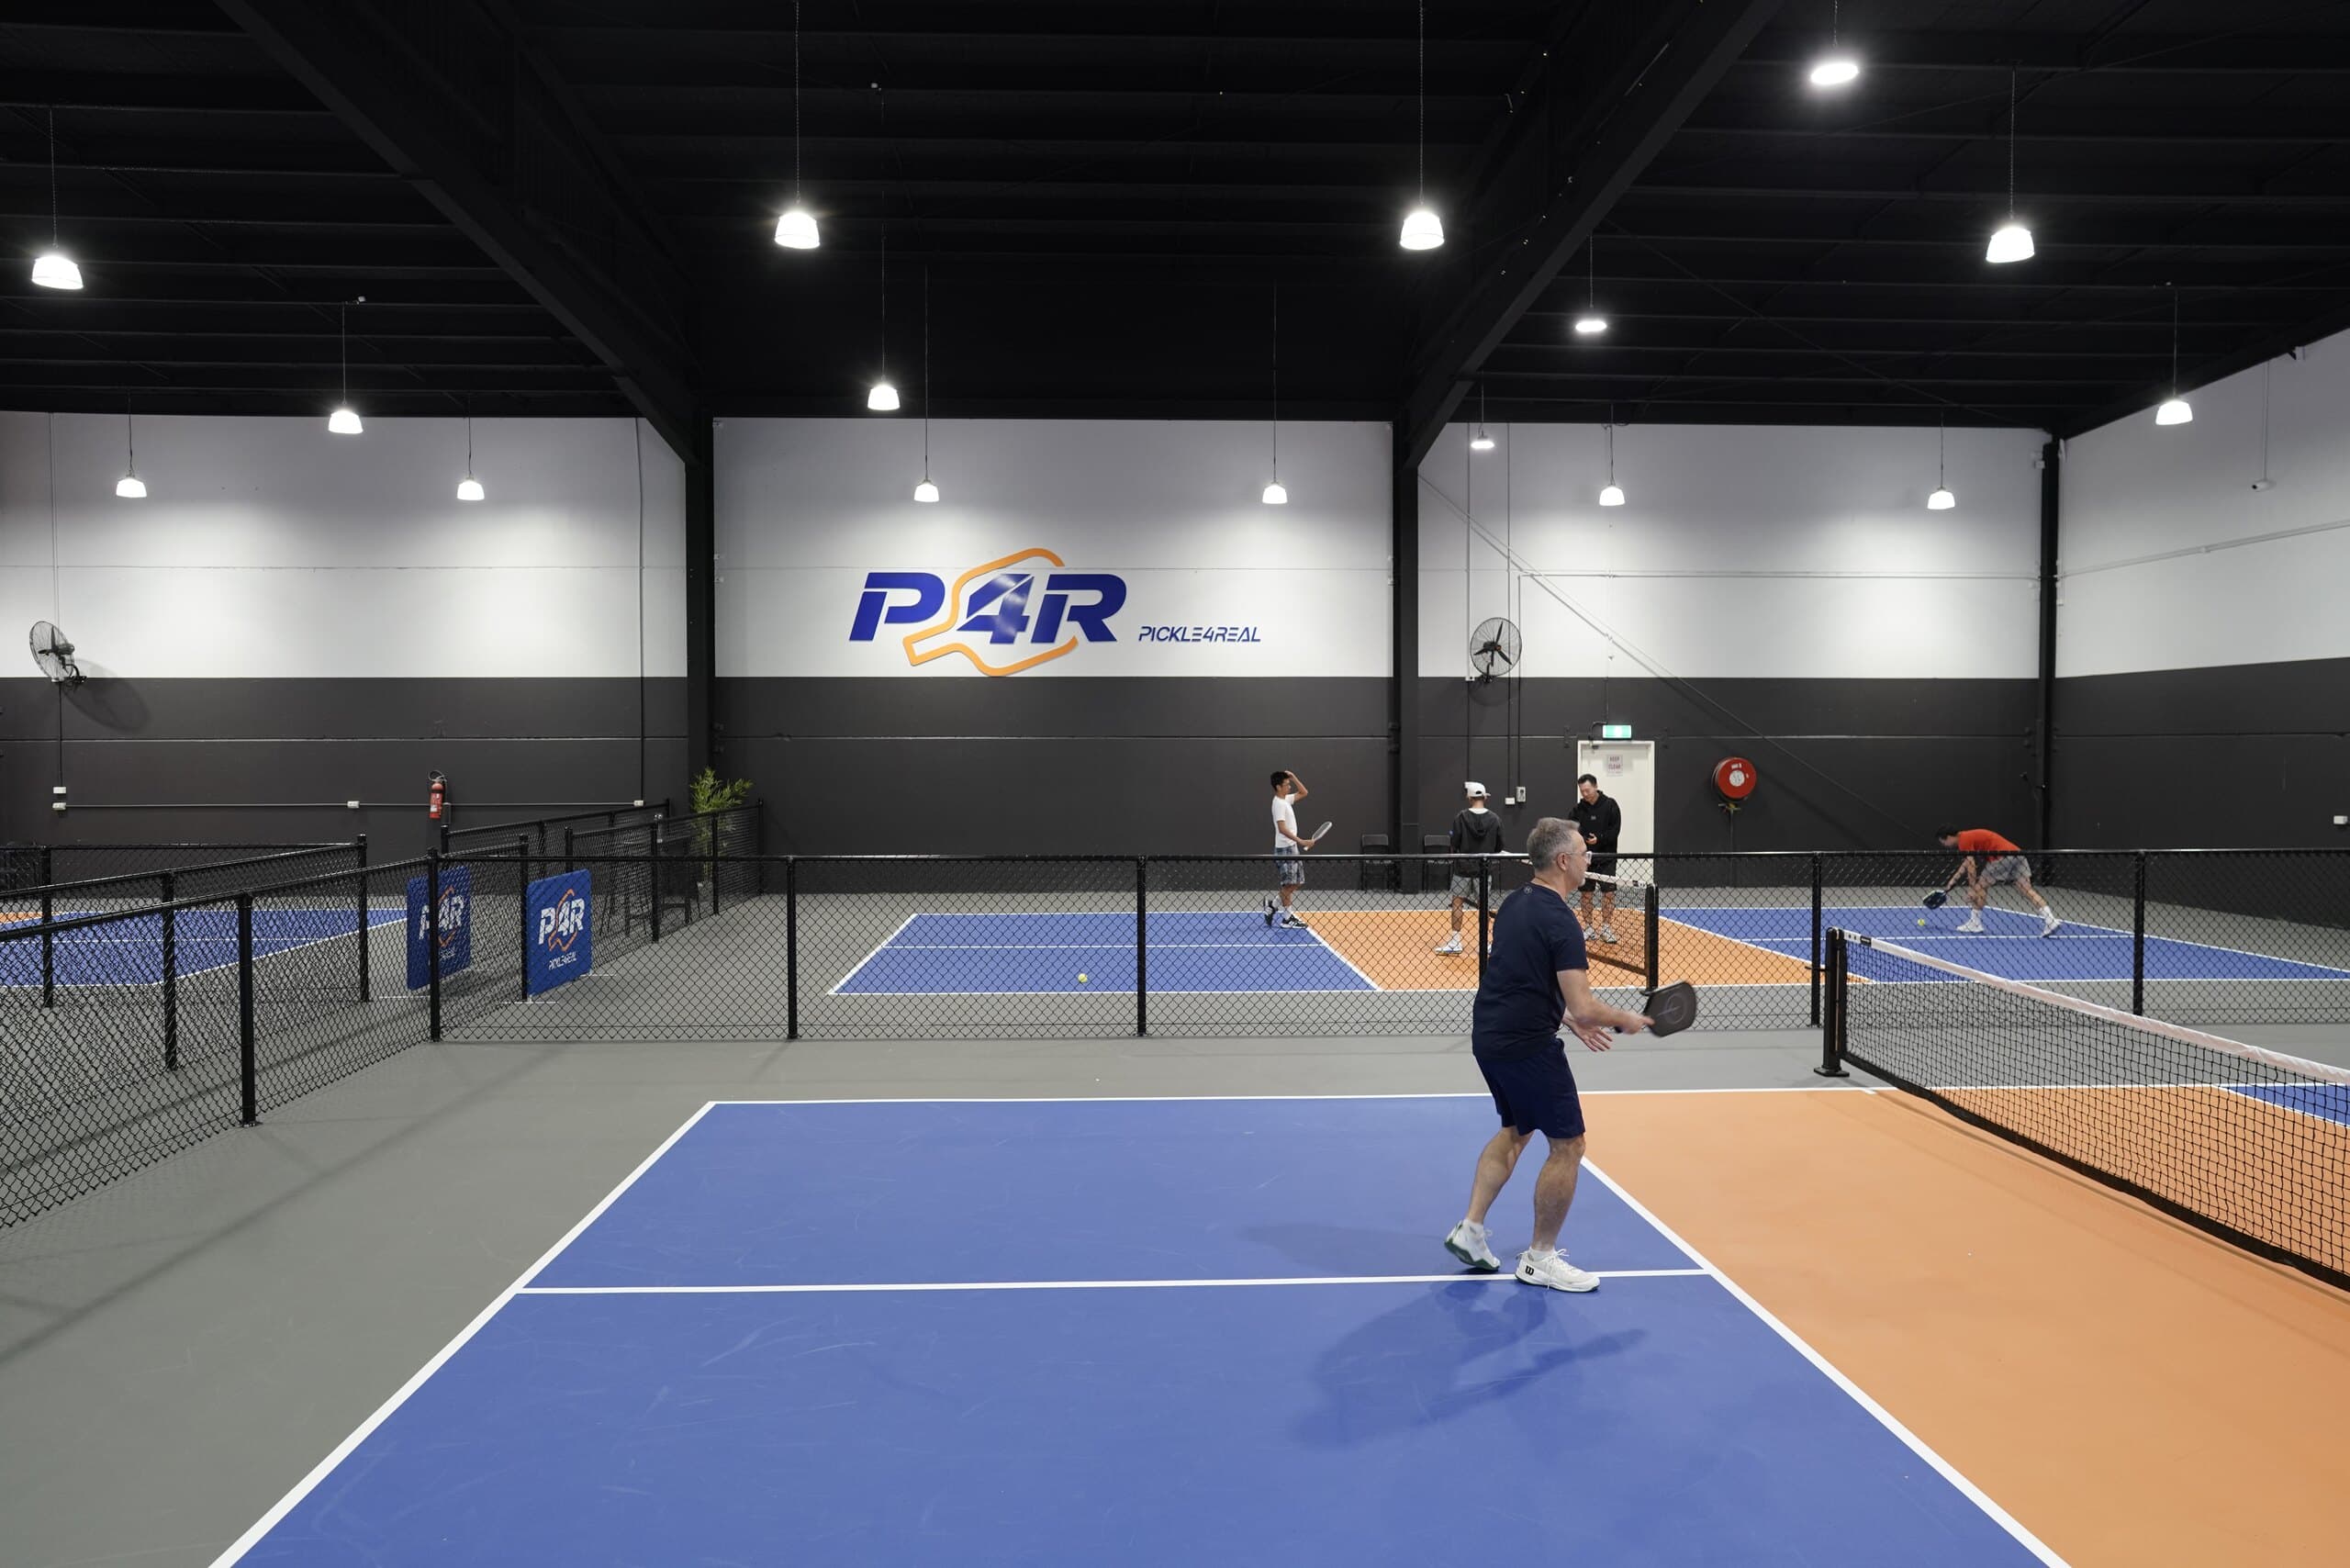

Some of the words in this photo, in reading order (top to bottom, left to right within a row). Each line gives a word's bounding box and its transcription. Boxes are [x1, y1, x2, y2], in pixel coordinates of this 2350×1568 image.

[849, 572, 1126, 644] P4R
[1138, 626, 1261, 642] PICKLE4REAL
[538, 898, 586, 945] P4R
